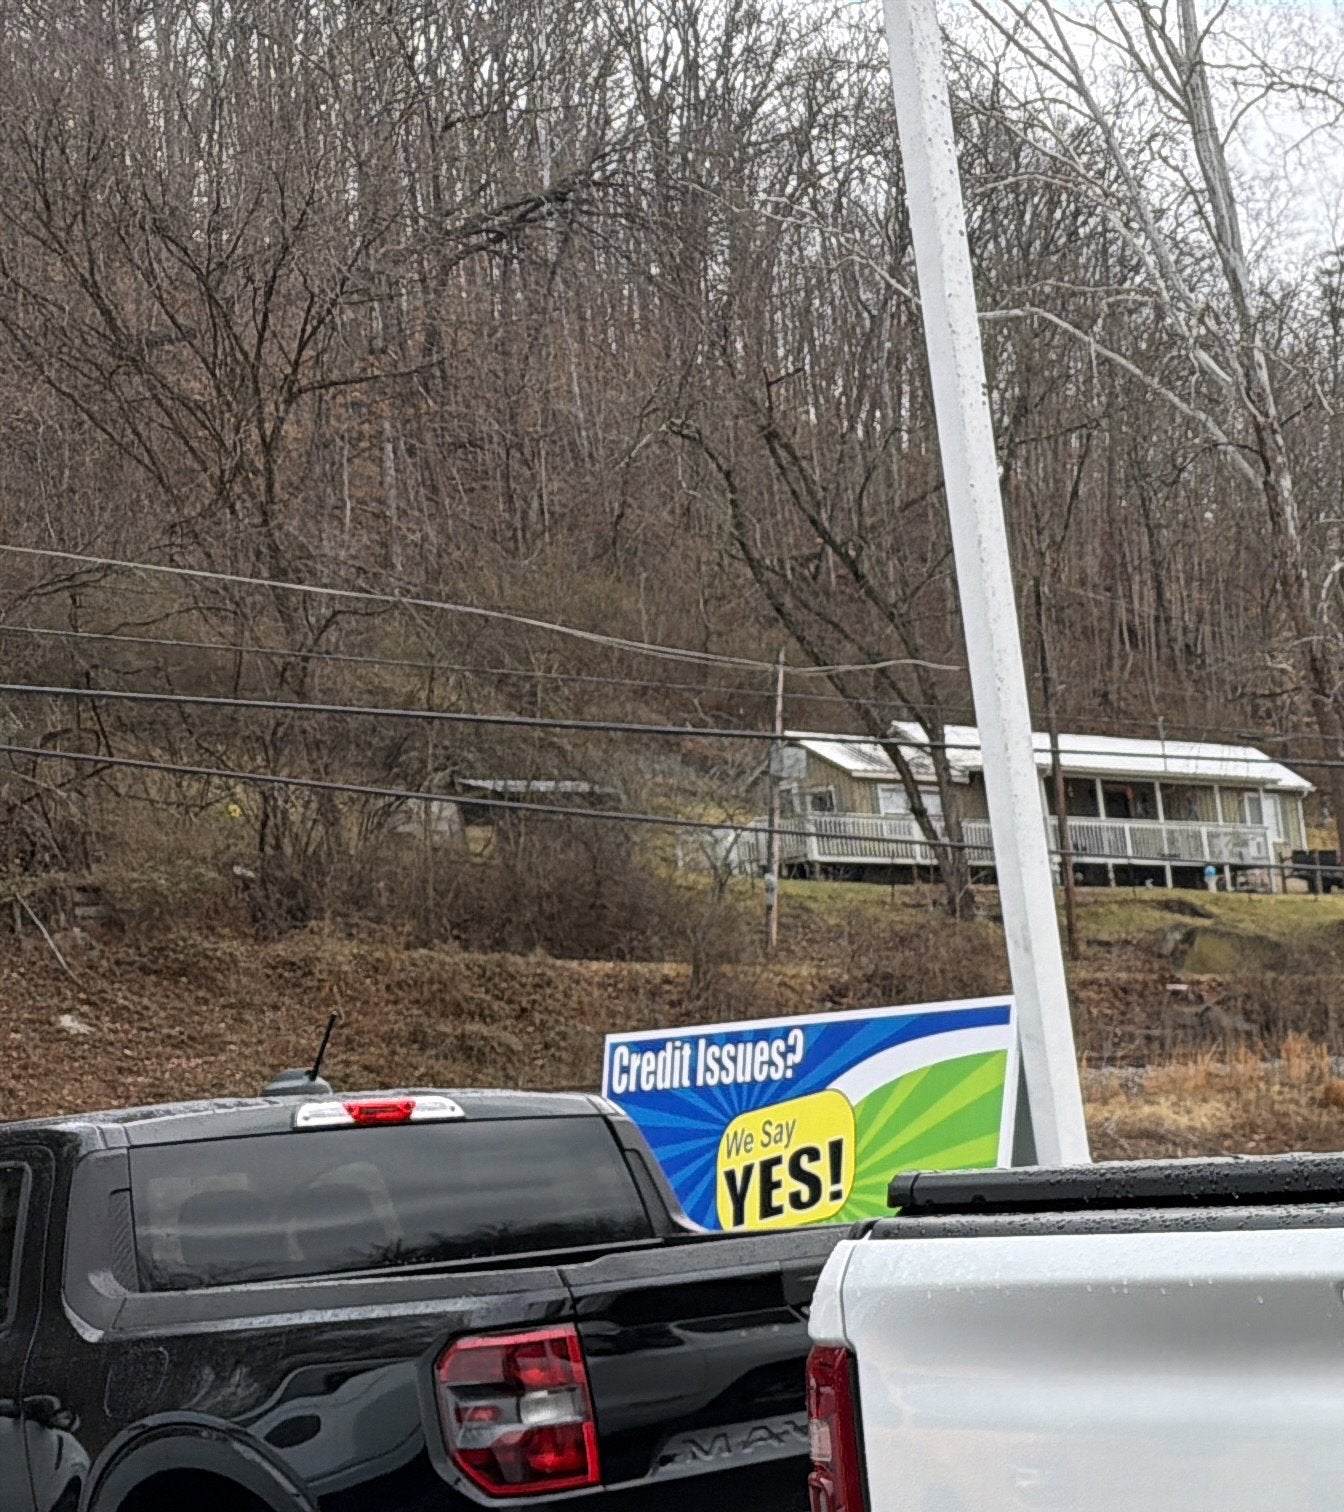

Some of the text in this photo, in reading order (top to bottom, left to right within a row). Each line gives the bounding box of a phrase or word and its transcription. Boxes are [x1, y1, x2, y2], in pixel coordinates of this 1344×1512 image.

[612, 1028, 805, 1095] Credit Issues?
[725, 1118, 797, 1159] We Say
[723, 1137, 844, 1228] YES!
